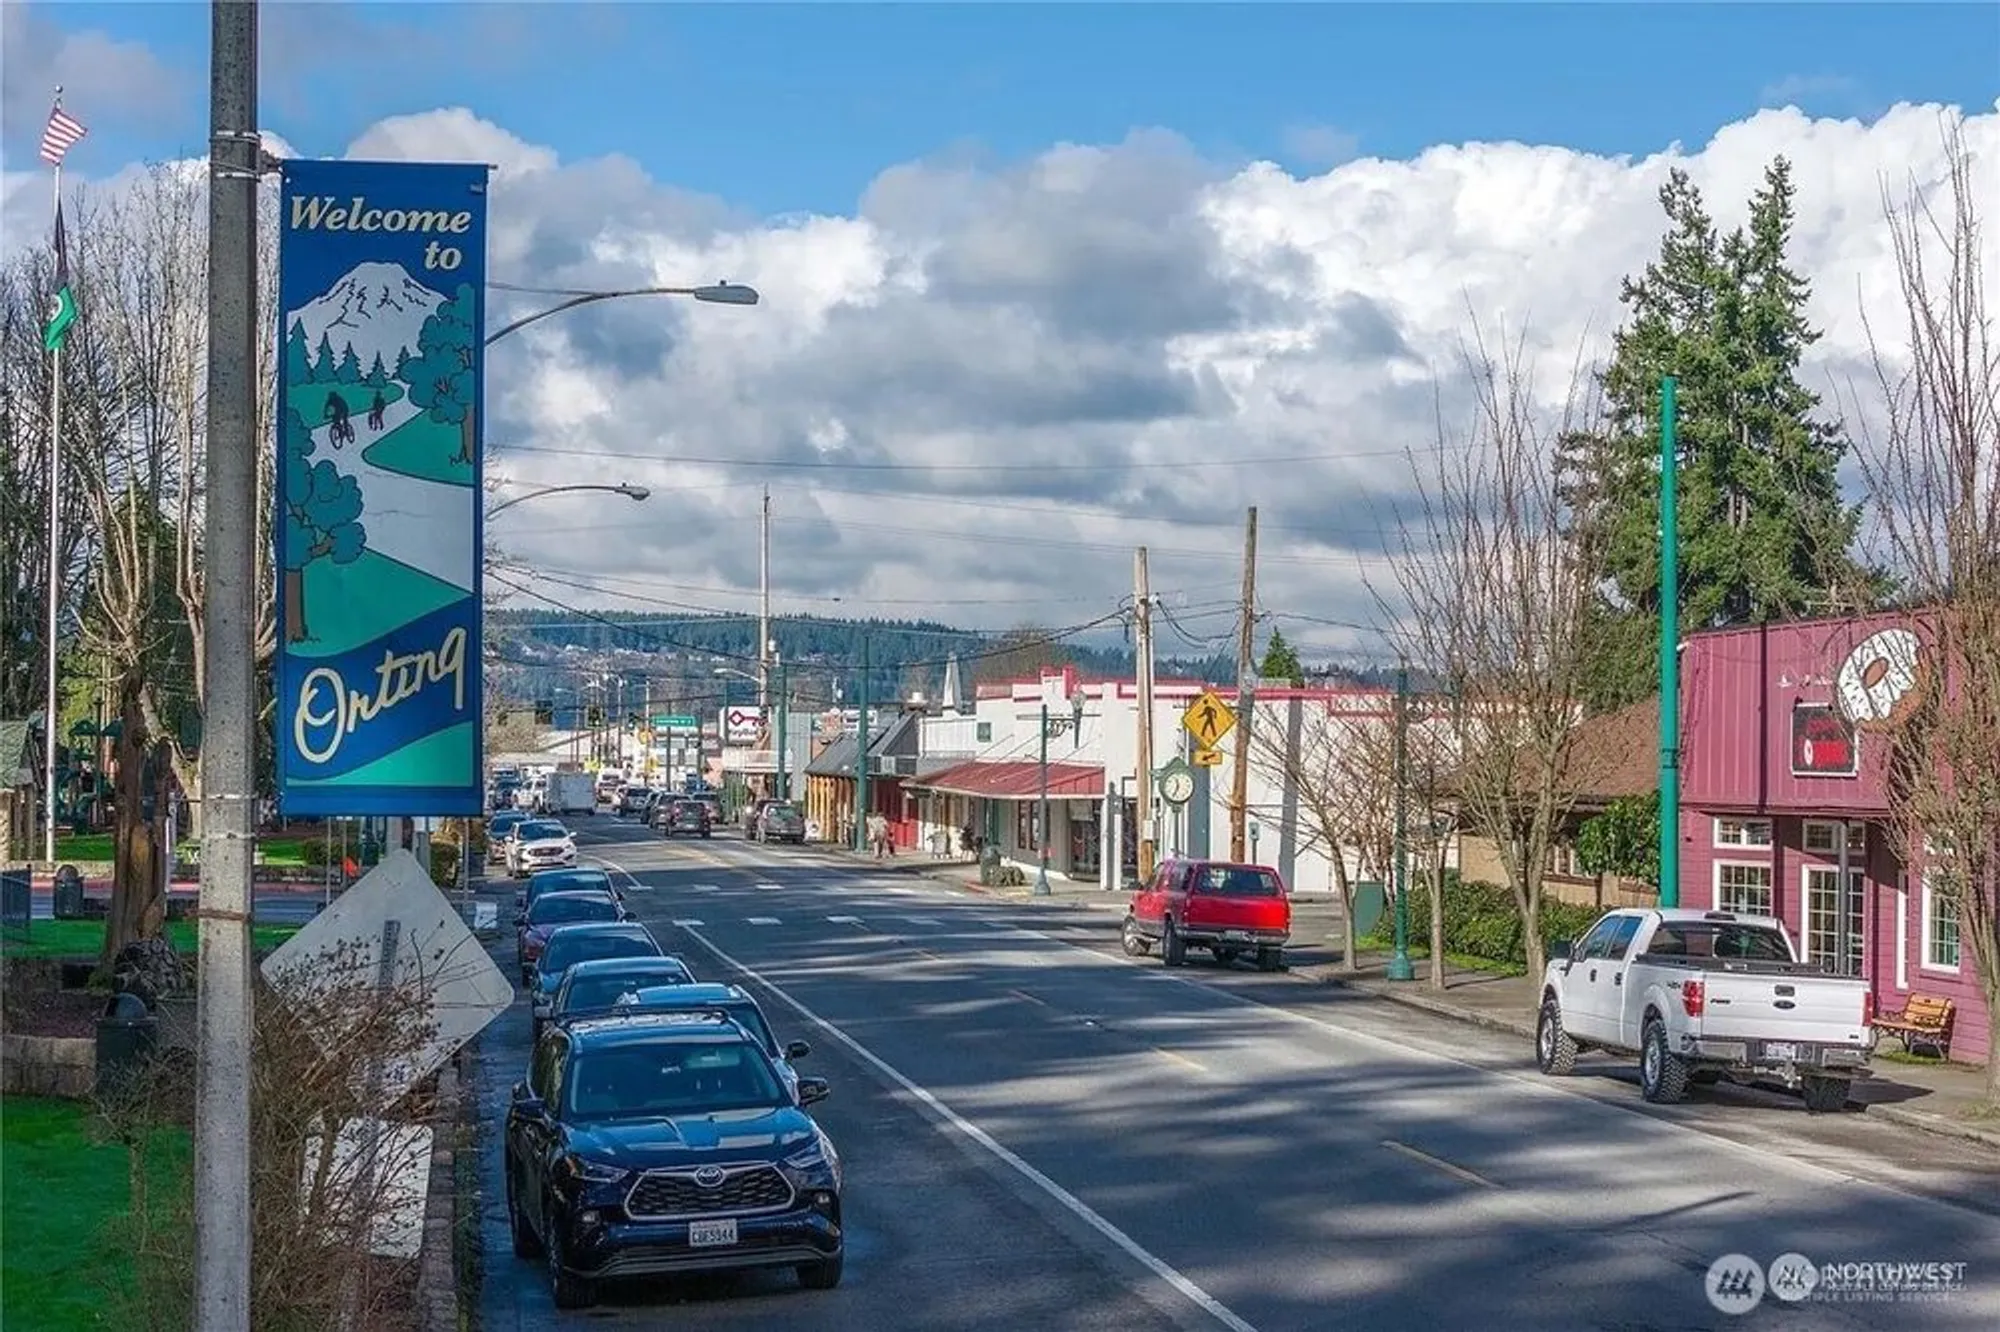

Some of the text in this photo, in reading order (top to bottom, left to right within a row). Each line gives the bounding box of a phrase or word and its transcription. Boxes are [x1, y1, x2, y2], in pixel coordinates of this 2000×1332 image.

[290, 195, 472, 233] Welcome
[424, 240, 463, 270] to
[294, 626, 468, 764] Orting
